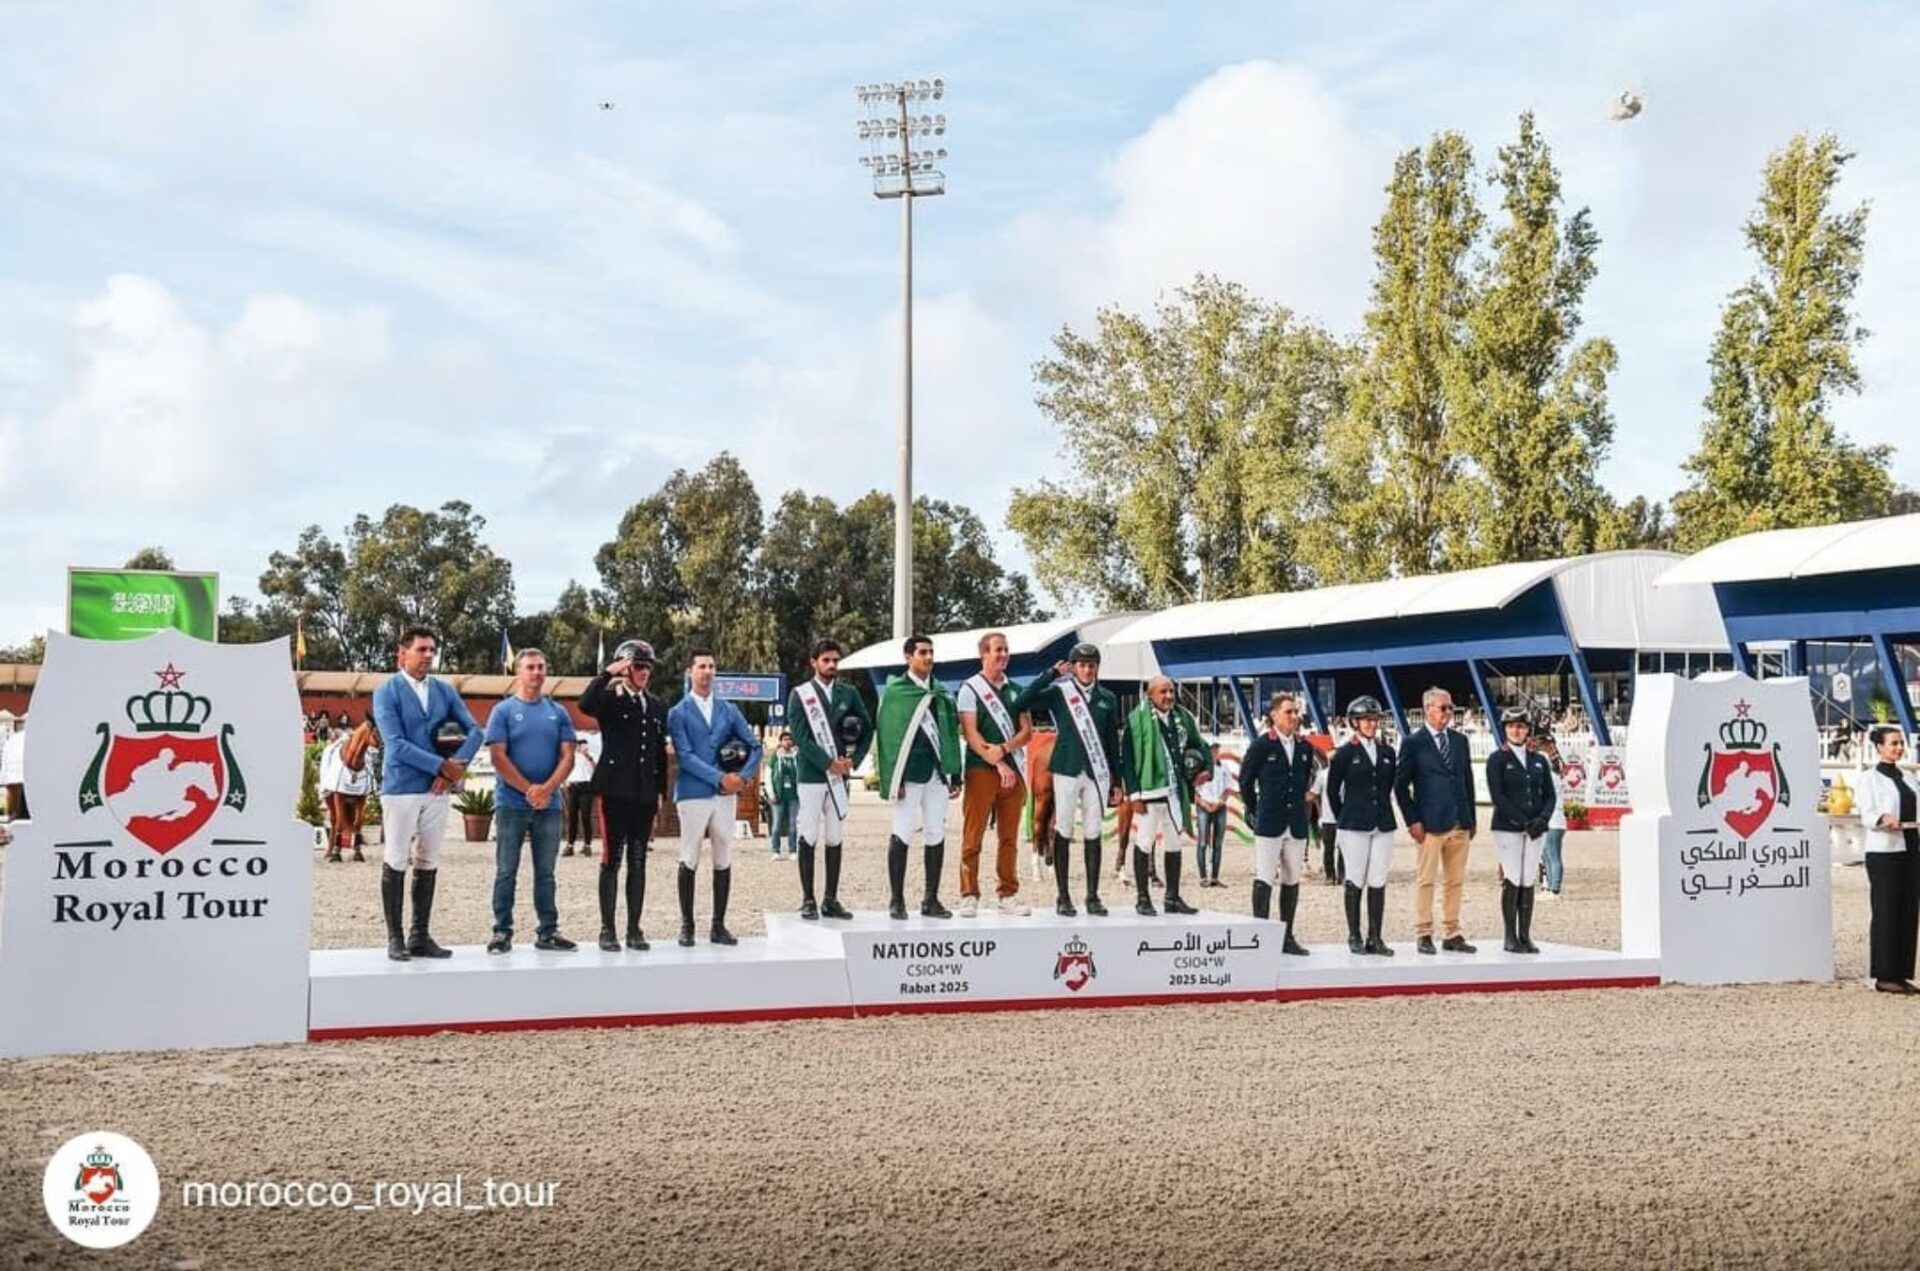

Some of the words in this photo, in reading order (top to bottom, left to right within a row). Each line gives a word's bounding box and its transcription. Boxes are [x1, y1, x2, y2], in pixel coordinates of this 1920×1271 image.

[52, 851, 268, 880] Morocco
[1680, 840, 1747, 870] الملكي
[1752, 839, 1809, 868] الدوري
[1680, 866, 1809, 900] المغربي
[53, 890, 166, 931] Royal
[177, 891, 268, 919] Tour
[872, 942, 954, 959] NATIONS
[960, 941, 996, 957] CUP
[1137, 932, 1201, 956] الأمم
[1206, 928, 1260, 954] كأس
[900, 982, 936, 995] Rabat
[939, 981, 969, 994] 2025
[1169, 974, 1197, 986] 2025
[1199, 973, 1231, 986] الرباط
